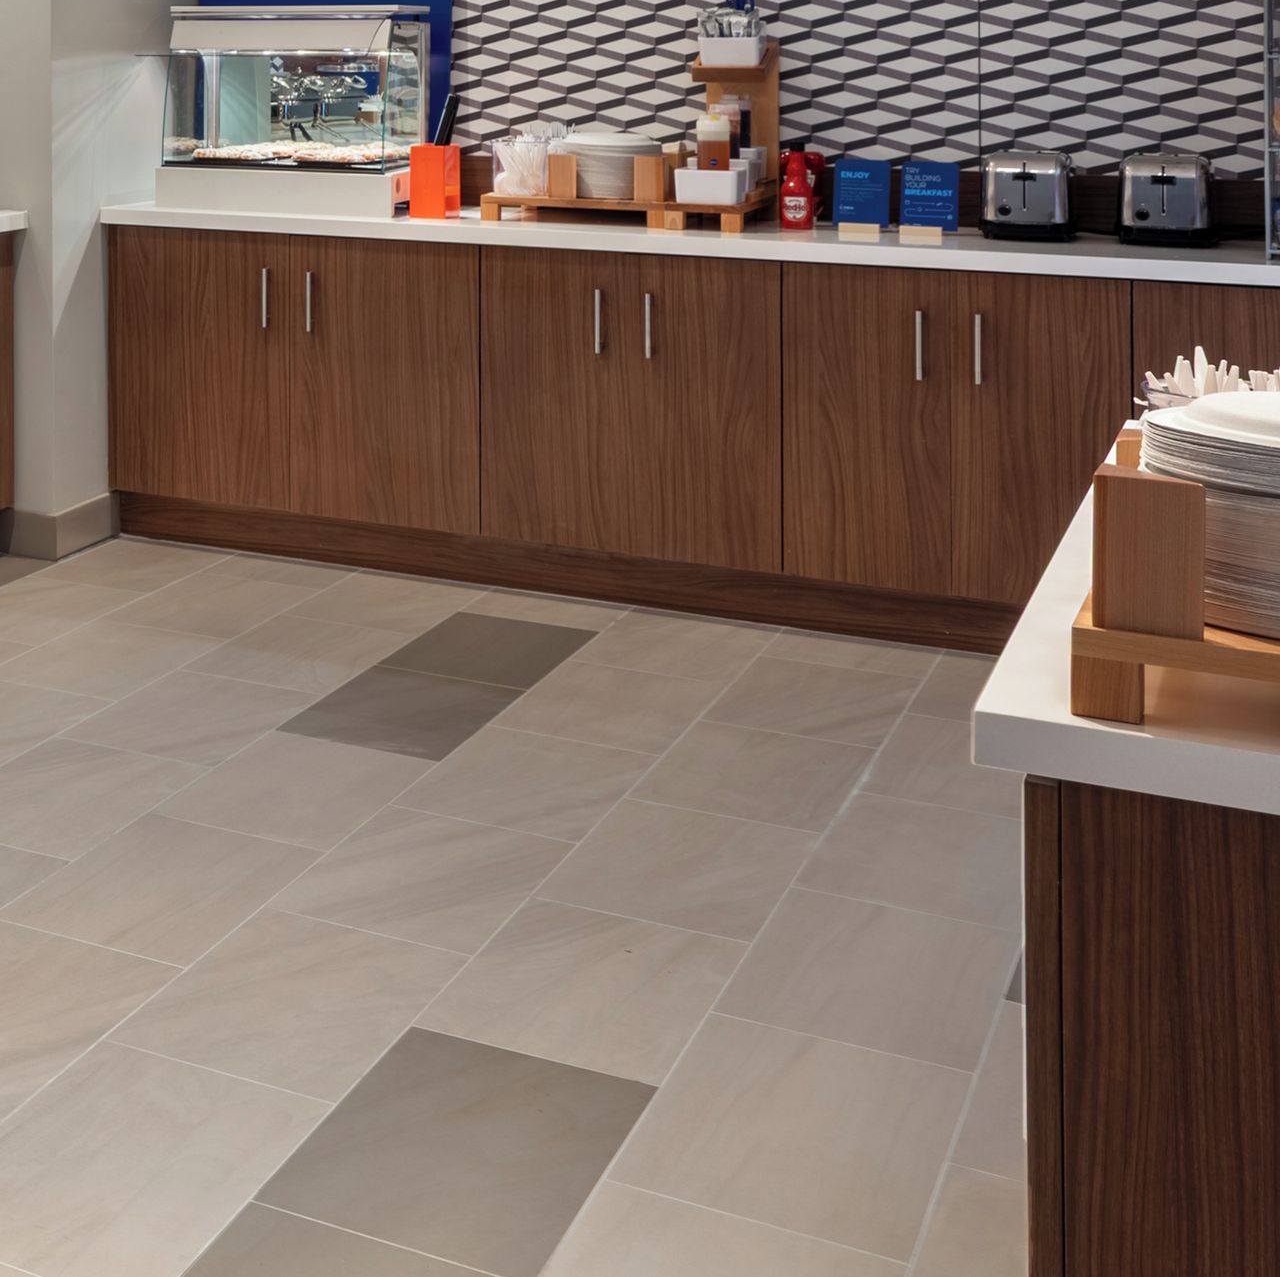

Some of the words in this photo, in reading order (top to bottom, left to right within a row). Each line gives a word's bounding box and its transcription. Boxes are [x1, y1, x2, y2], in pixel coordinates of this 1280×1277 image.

[840, 170, 871, 179] ENJOY
[905, 174, 942, 182] BUILDING
[905, 181, 927, 189] YOUR
[904, 188, 953, 197] BREAKFAST
